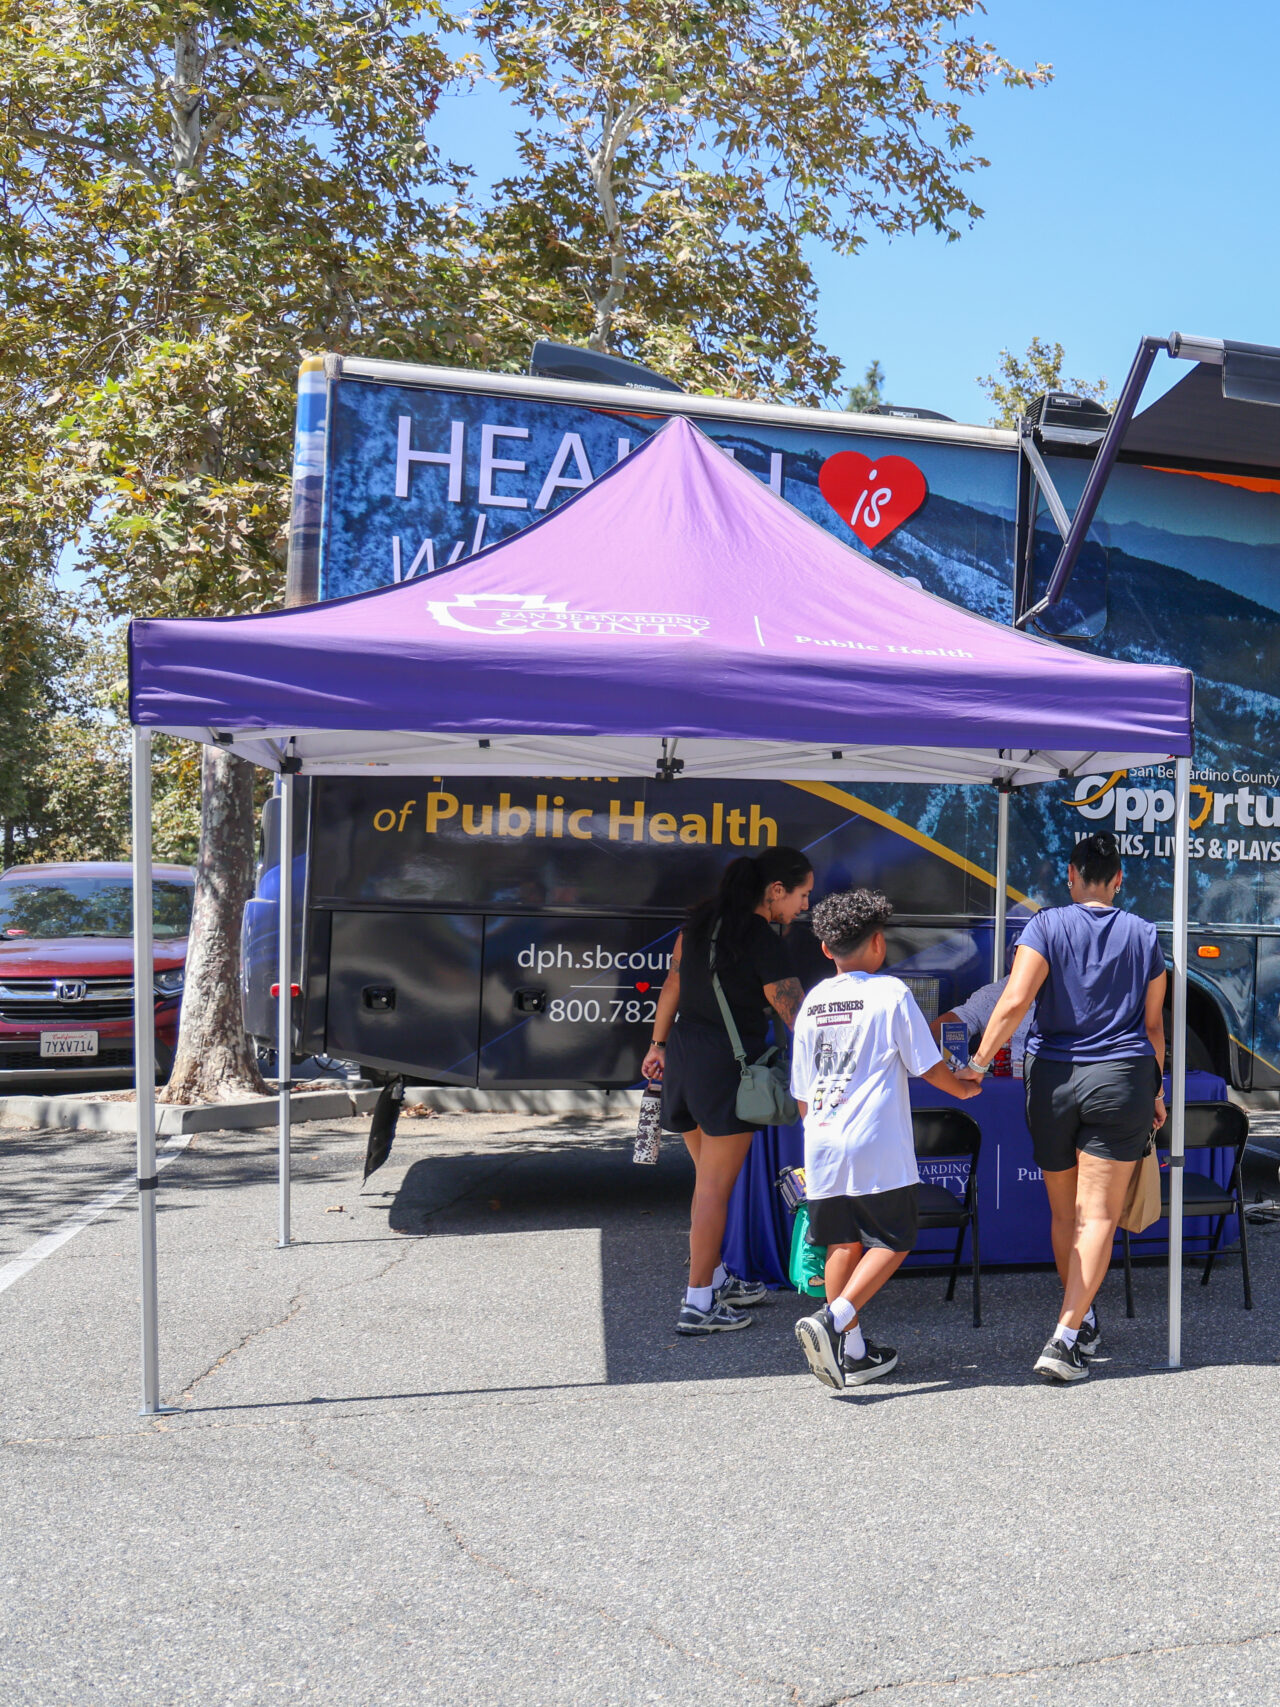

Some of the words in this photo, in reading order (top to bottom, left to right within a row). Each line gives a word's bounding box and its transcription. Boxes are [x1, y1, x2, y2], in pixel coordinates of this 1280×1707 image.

[395, 415, 784, 511] HEA
[850, 469, 892, 528] is
[495, 618, 711, 637] COUNTY
[500, 610, 547, 620] SAN
[555, 612, 711, 627] BERNARDINO
[794, 635, 881, 651] Public
[885, 644, 974, 659] Health
[1129, 766, 1154, 778] San
[1232, 770, 1280, 788] County
[373, 800, 416, 833] of
[426, 791, 594, 840] Public
[608, 799, 778, 847] Health
[1208, 838, 1223, 860] &
[550, 999, 657, 1023] 800.782
[828, 999, 864, 1013] STRYKERS
[45, 1041, 94, 1053] 7YXV714
[917, 1163, 972, 1176] ARDINO
[1017, 1166, 1045, 1182] Pub
